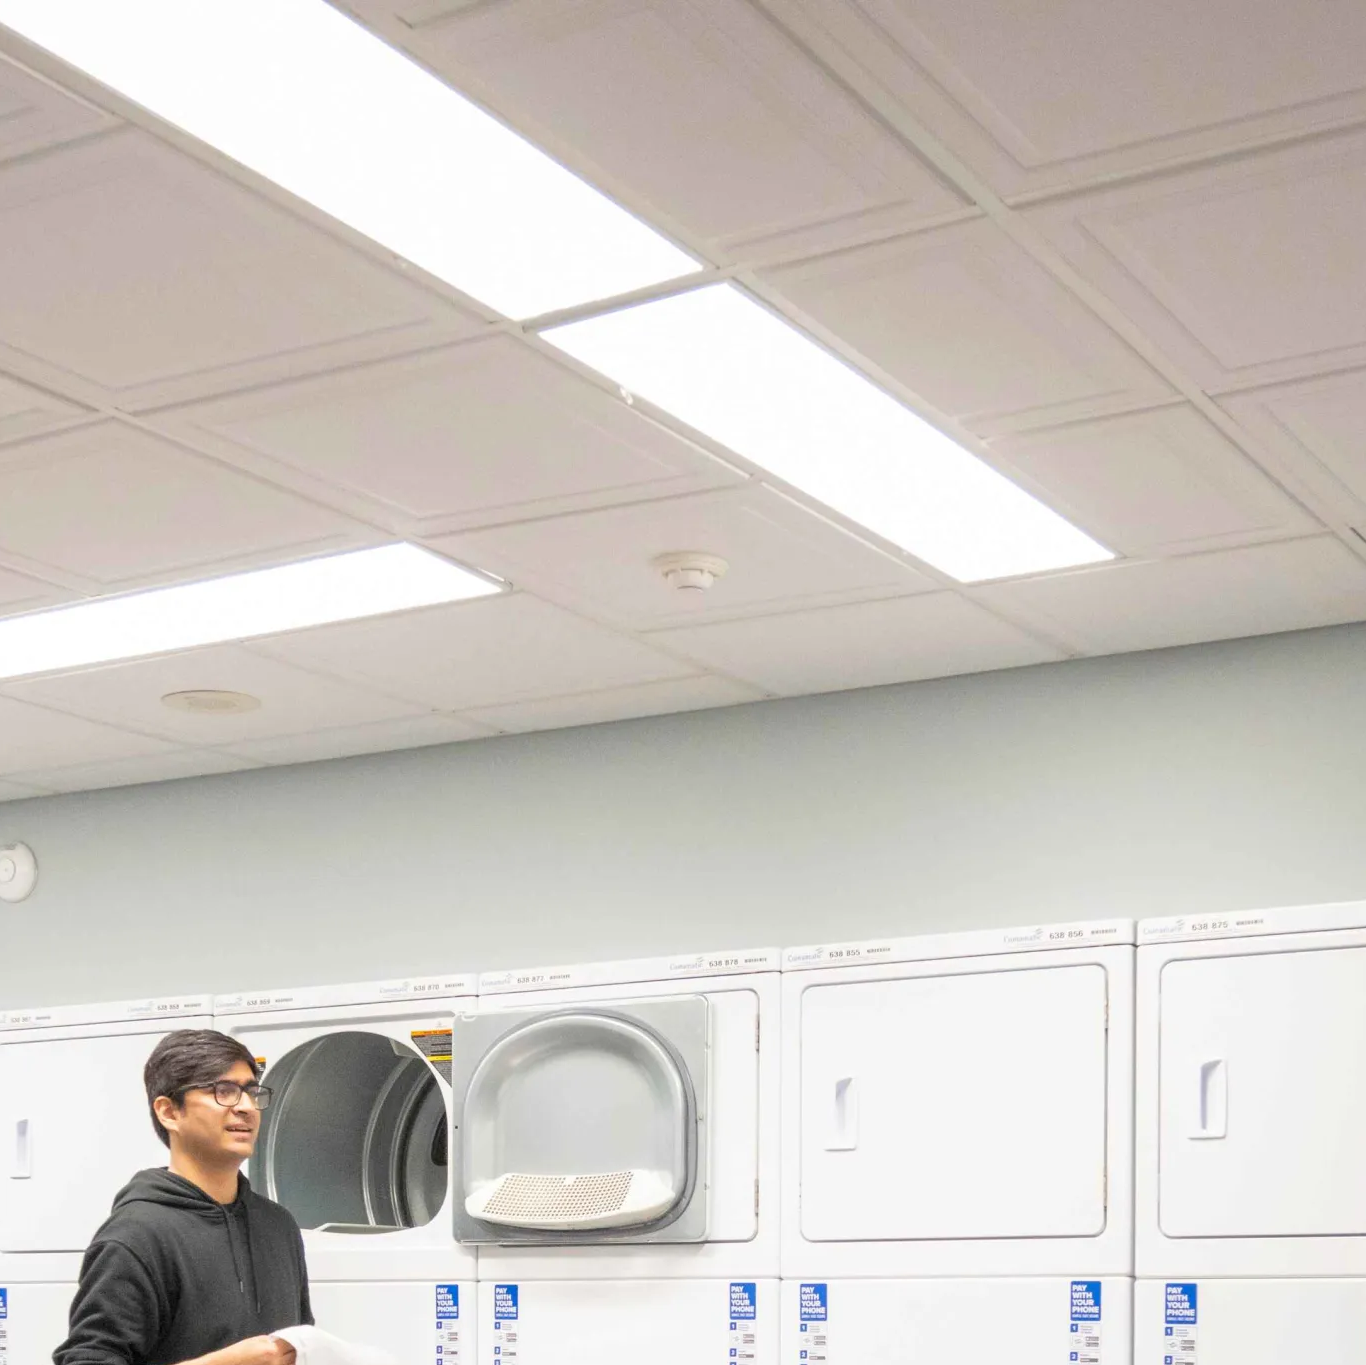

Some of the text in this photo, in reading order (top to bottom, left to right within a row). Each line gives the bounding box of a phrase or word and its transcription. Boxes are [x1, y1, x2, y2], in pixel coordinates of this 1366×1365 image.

[1049, 931, 1065, 940] 638
[829, 949, 844, 959] 638
[1072, 1284, 1088, 1292] PAY
[1166, 1286, 1183, 1294] PAY
[1166, 1301, 1190, 1309] YOUR
[1072, 1306, 1099, 1314] PHONE
